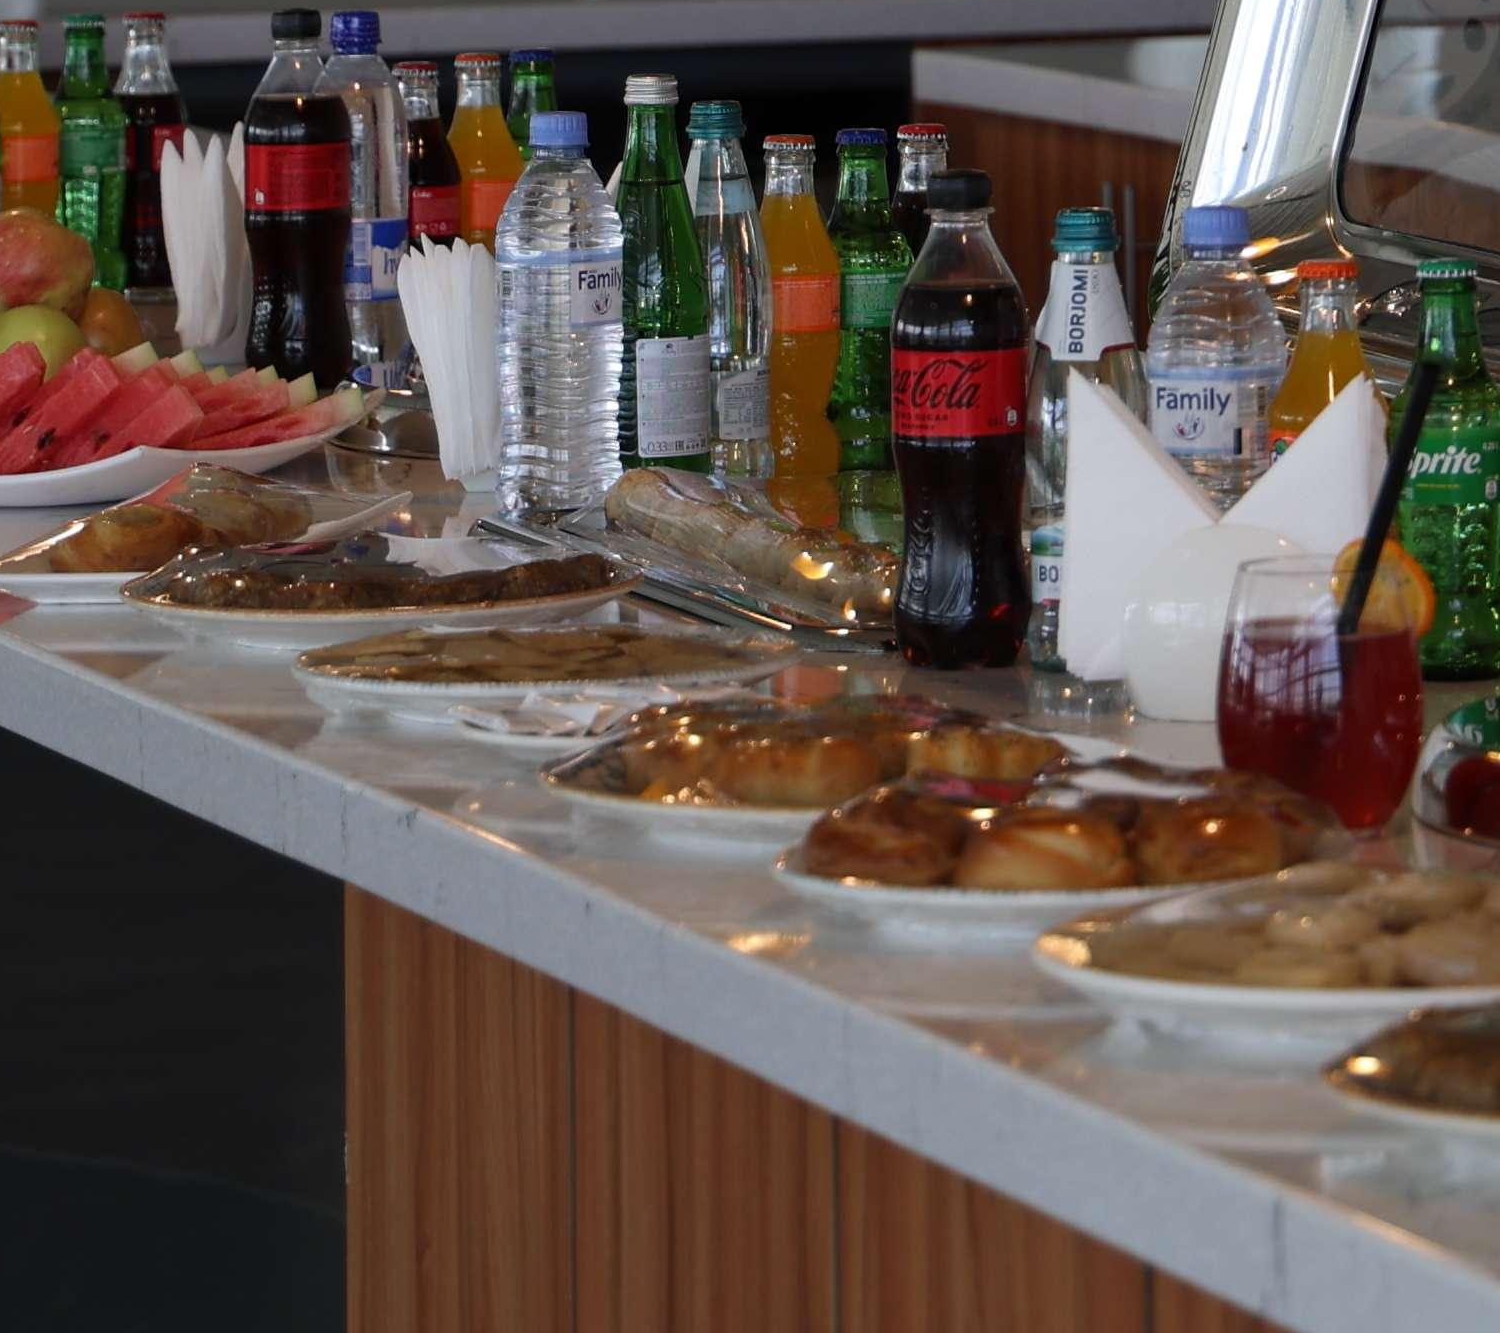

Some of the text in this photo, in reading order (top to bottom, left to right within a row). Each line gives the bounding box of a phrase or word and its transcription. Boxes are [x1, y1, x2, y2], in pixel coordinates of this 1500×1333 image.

[578, 267, 622, 292] Family
[1068, 269, 1088, 354] BORJOMI
[1156, 387, 1231, 416] Family
